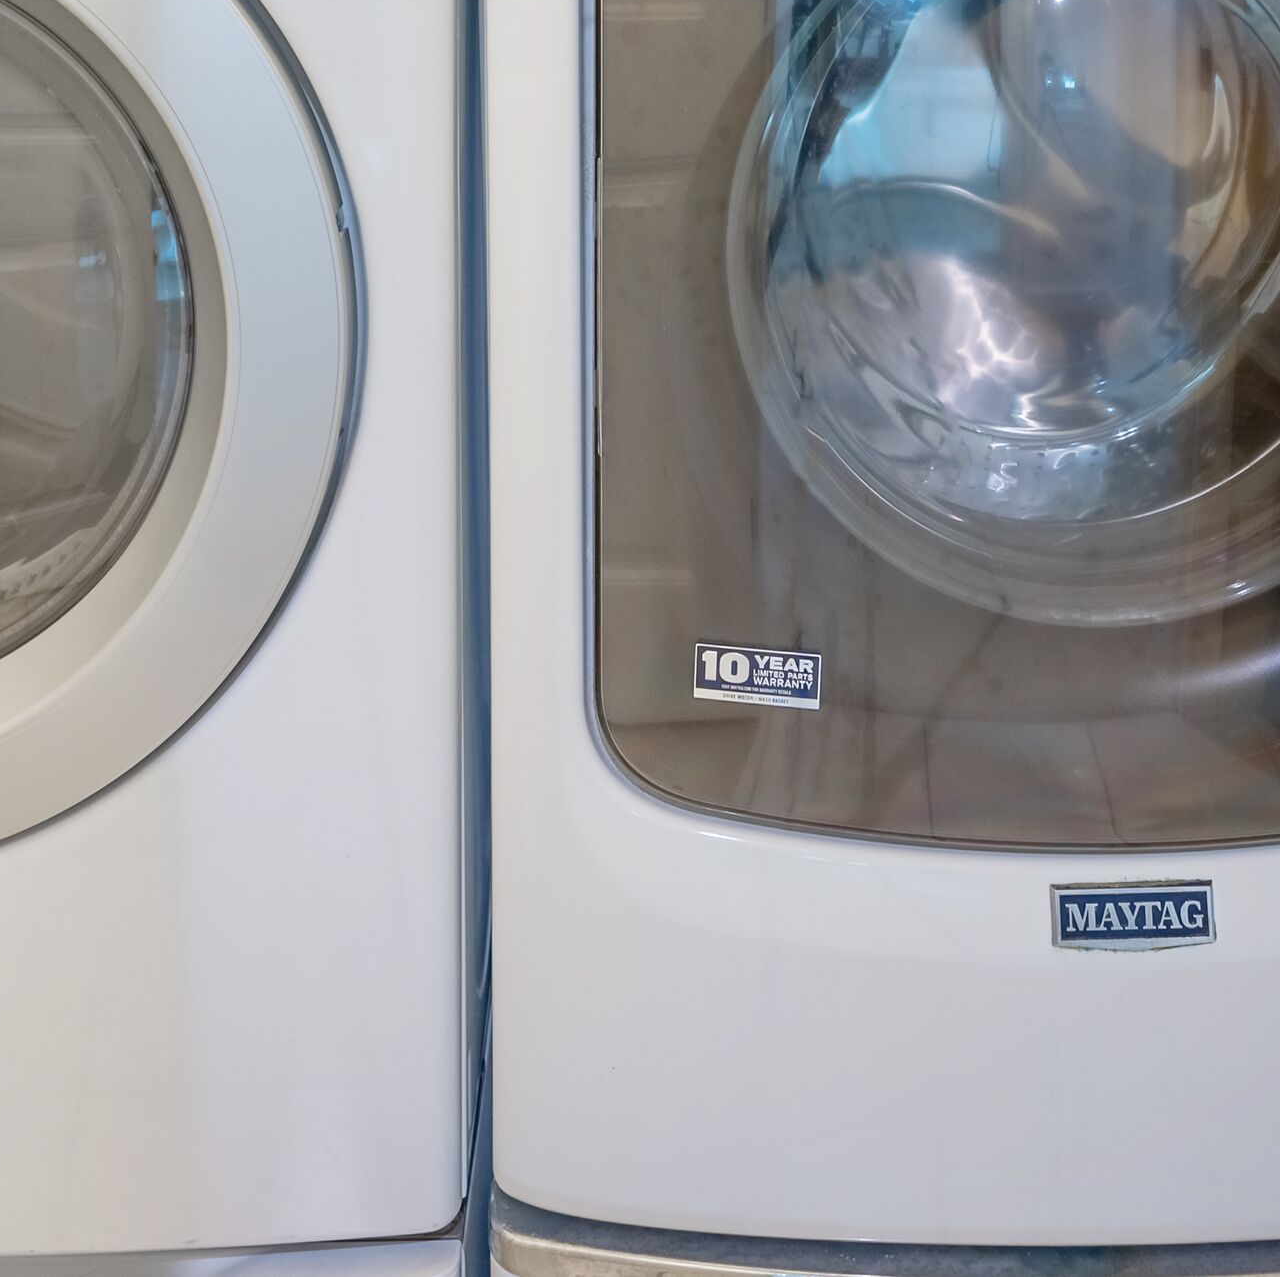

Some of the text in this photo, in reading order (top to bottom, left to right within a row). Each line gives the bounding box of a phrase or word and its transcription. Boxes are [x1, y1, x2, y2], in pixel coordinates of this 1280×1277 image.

[702, 650, 750, 684] 10
[754, 655, 813, 673] YEAR
[753, 669, 813, 681] LIMITED PARTS
[753, 677, 812, 690] WARRANTY
[1065, 900, 1205, 931] MAYTAG
